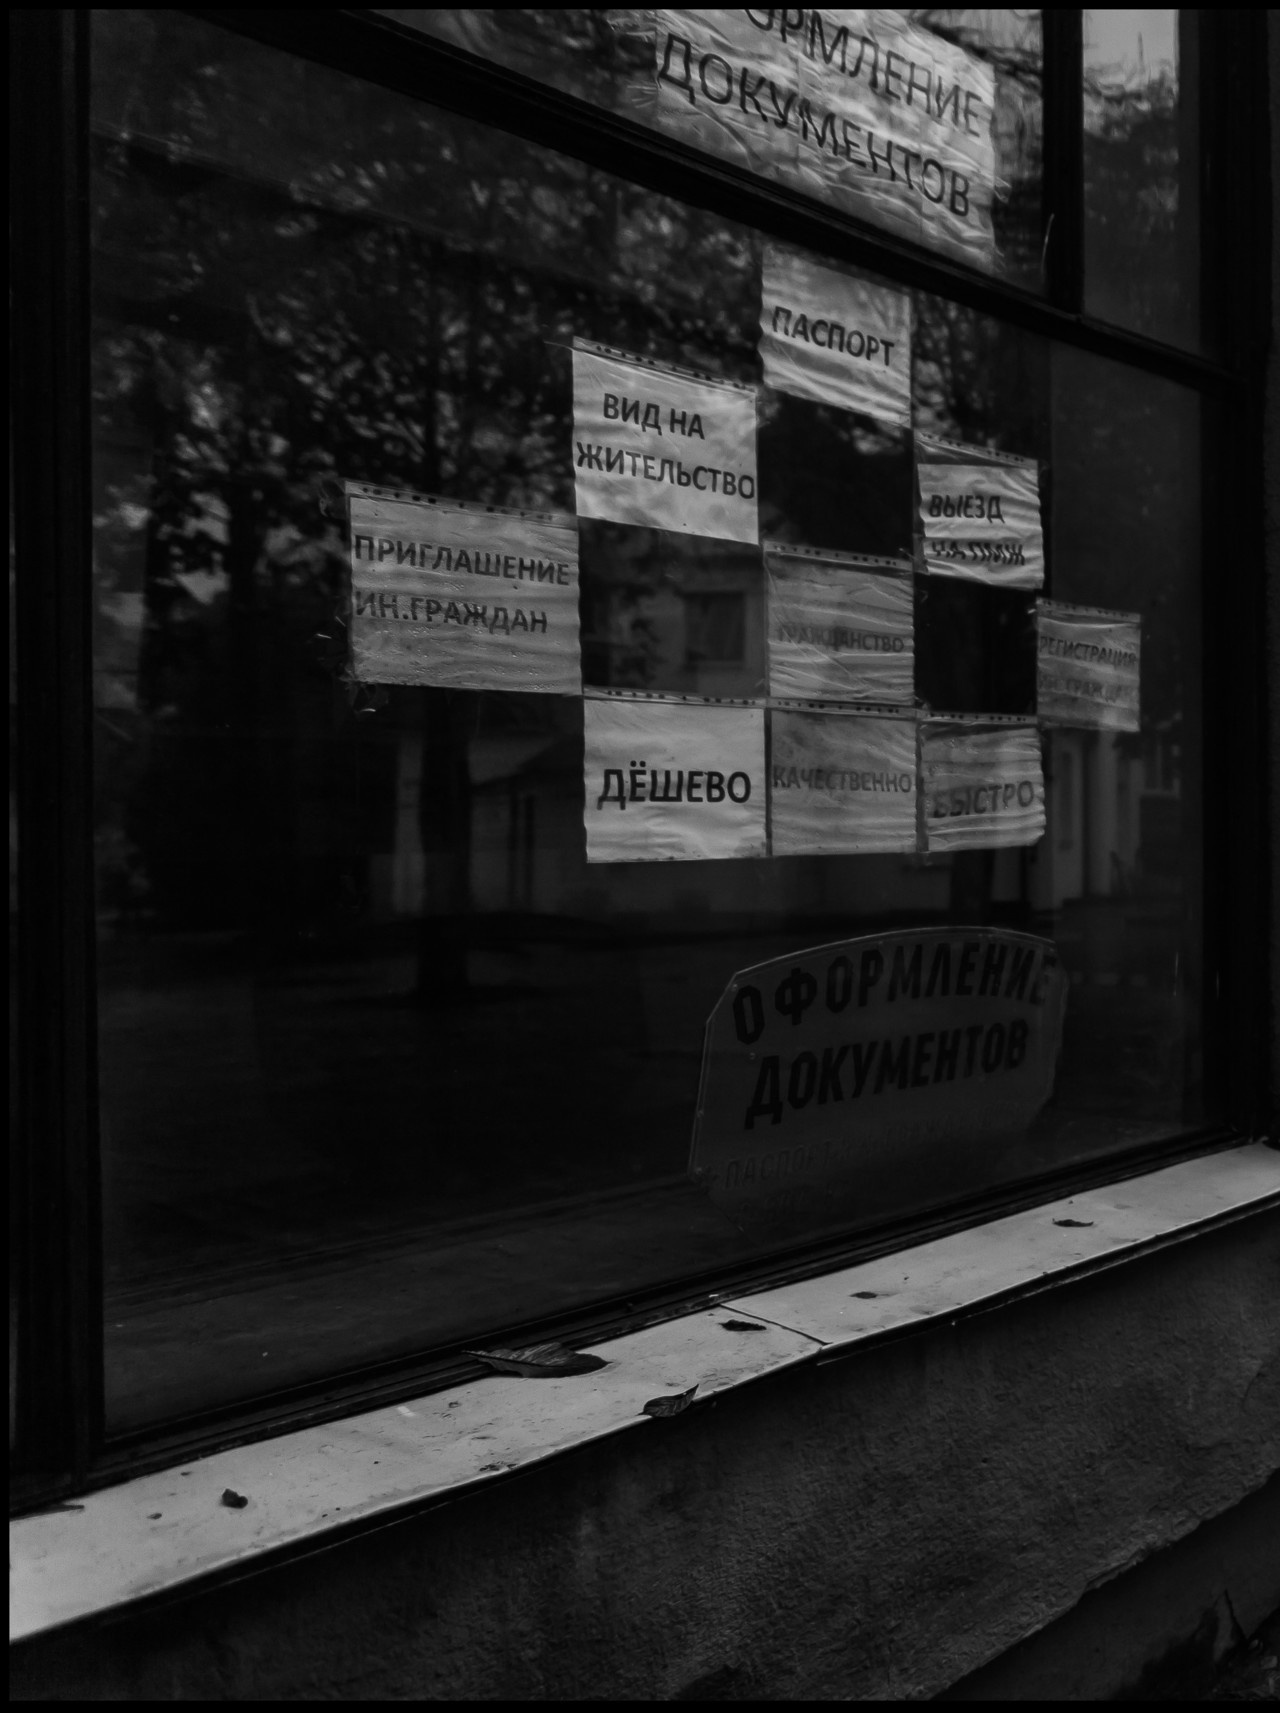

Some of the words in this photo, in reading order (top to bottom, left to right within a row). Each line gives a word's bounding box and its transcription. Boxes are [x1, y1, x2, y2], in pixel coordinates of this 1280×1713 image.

[656, 33, 969, 216] ДОКУМЕНТОВ
[772, 306, 894, 366] ПАСПОРТ
[604, 393, 662, 436] ВИД
[670, 410, 705, 440] НА
[576, 441, 754, 499] ЖИТЕЛЬСТВО
[929, 495, 1005, 523] ВЫЕЗД
[355, 535, 569, 586] ПРИГЛАШЕНИЕ
[968, 542, 1025, 565] ПМЖ
[1040, 636, 1137, 669] РЕГИСТРАЦИЯ
[597, 761, 750, 810] ДЁШЕВО
[774, 767, 911, 793] КАЧЕСТВЕННО
[933, 780, 1034, 818] БЫСТРО
[744, 1018, 1029, 1130] ДОКУМЕНТОВ
